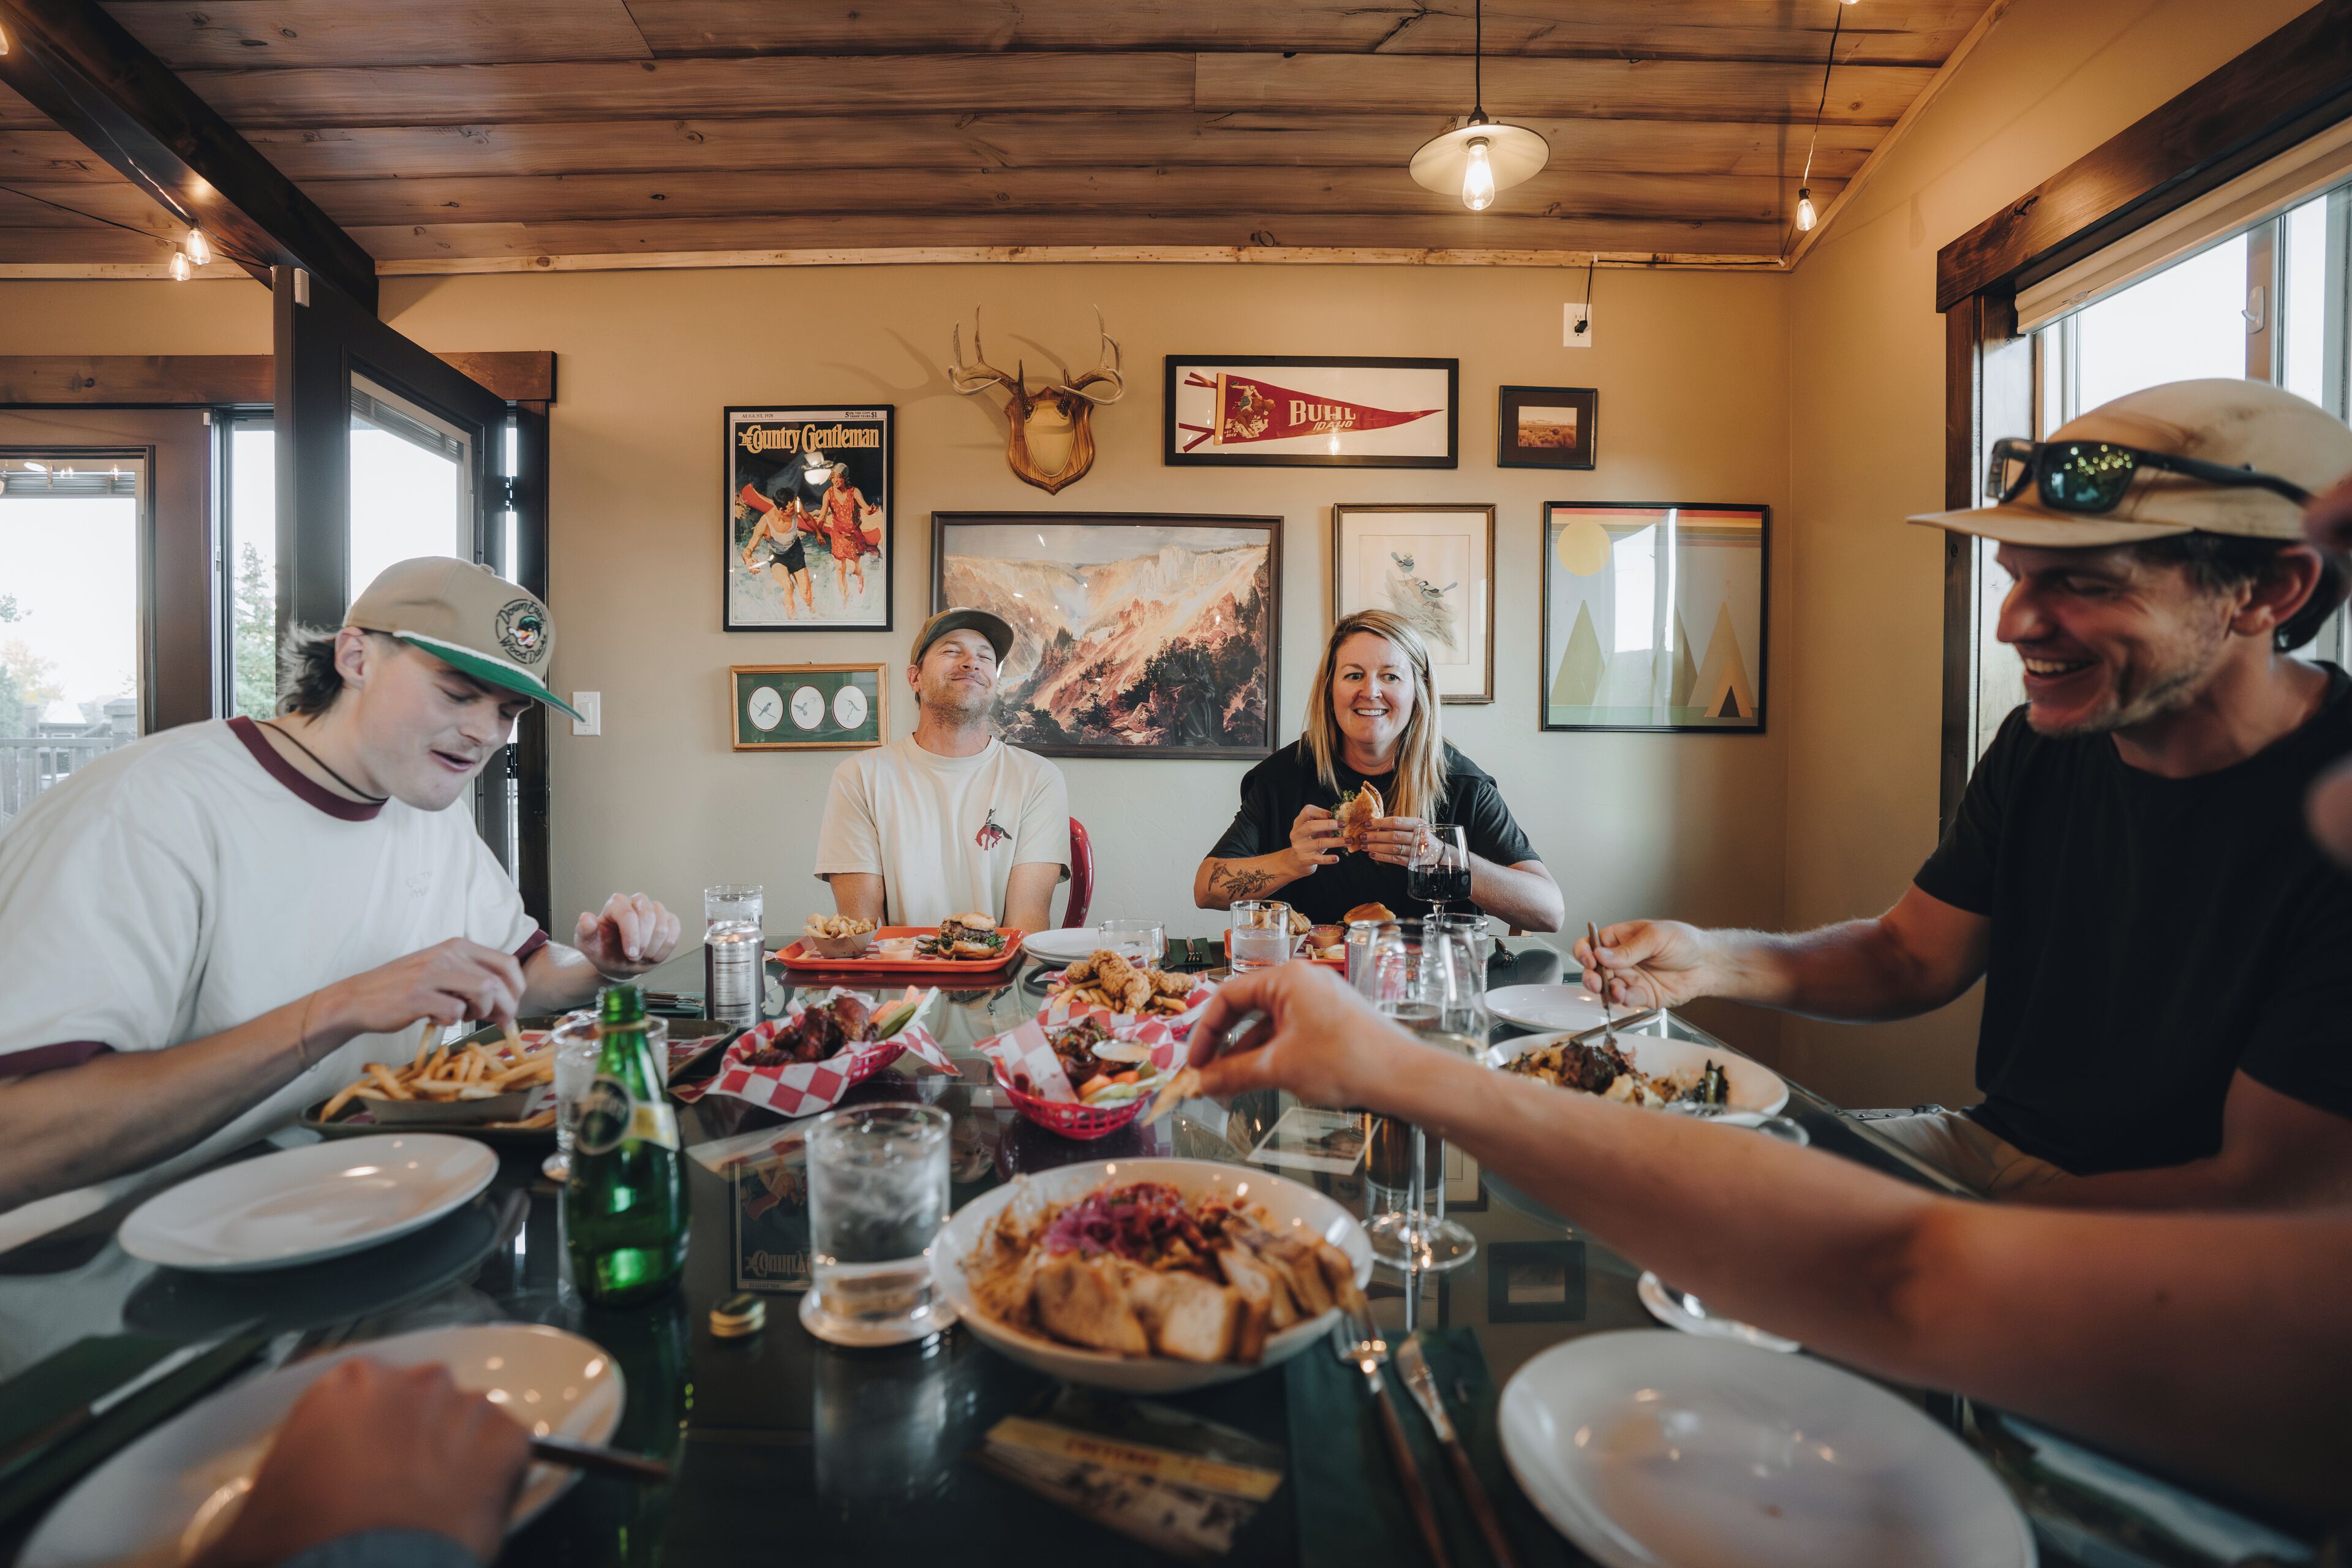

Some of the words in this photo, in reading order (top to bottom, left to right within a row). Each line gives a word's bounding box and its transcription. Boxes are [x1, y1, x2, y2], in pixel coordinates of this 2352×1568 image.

[1288, 400, 1356, 427] BUHL
[1313, 420, 1353, 431] IDAHO
[746, 424, 801, 454] Country
[801, 424, 880, 453] Gentleman
